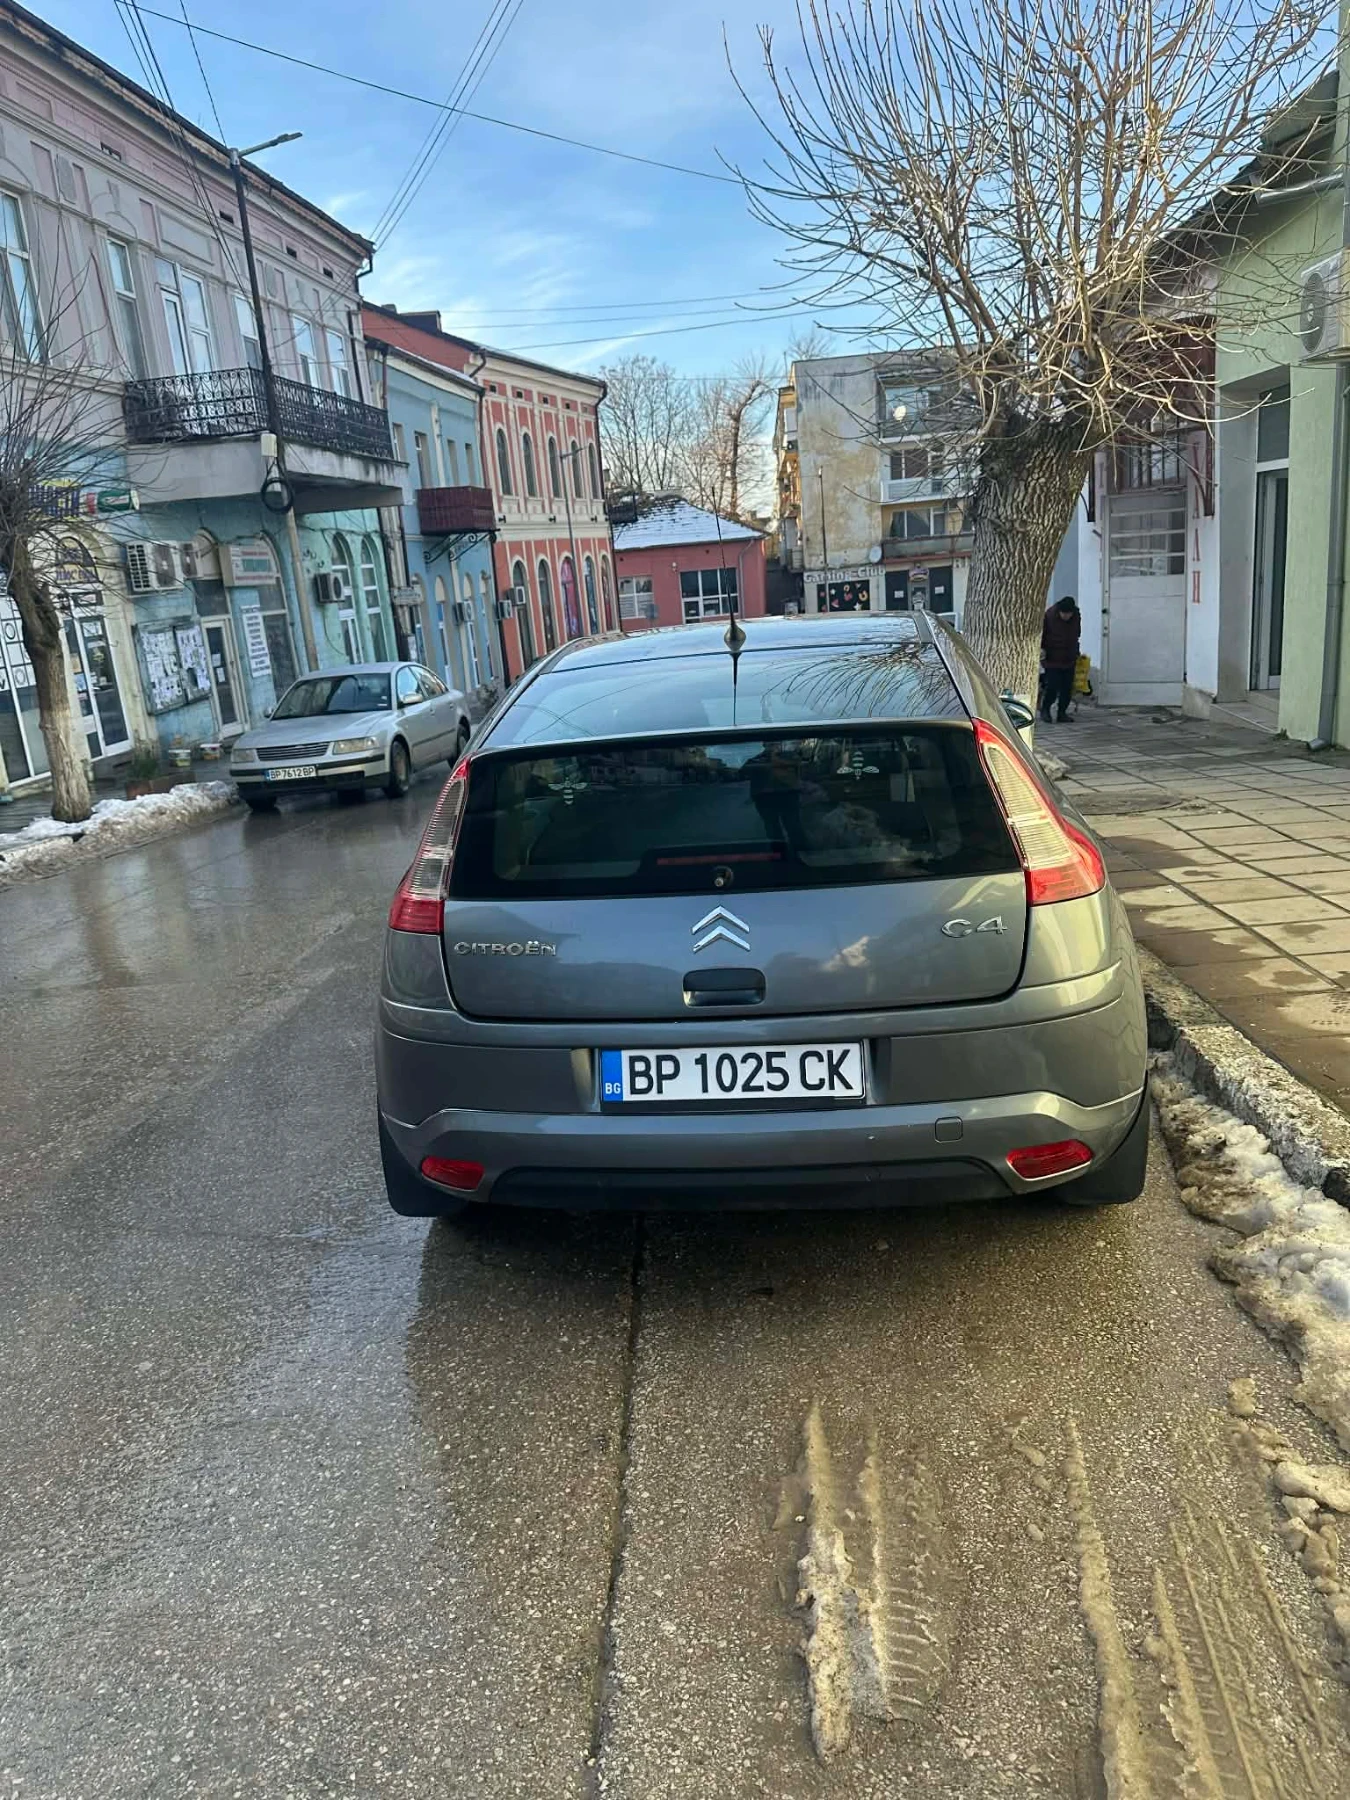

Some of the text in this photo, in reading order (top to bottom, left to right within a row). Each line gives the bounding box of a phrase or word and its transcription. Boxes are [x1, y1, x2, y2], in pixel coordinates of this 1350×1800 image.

[941, 915, 1008, 938] C4
[453, 940, 557, 956] CITROËN
[628, 1049, 854, 1095] BP 1025 CK
[605, 1083, 621, 1094] BG
